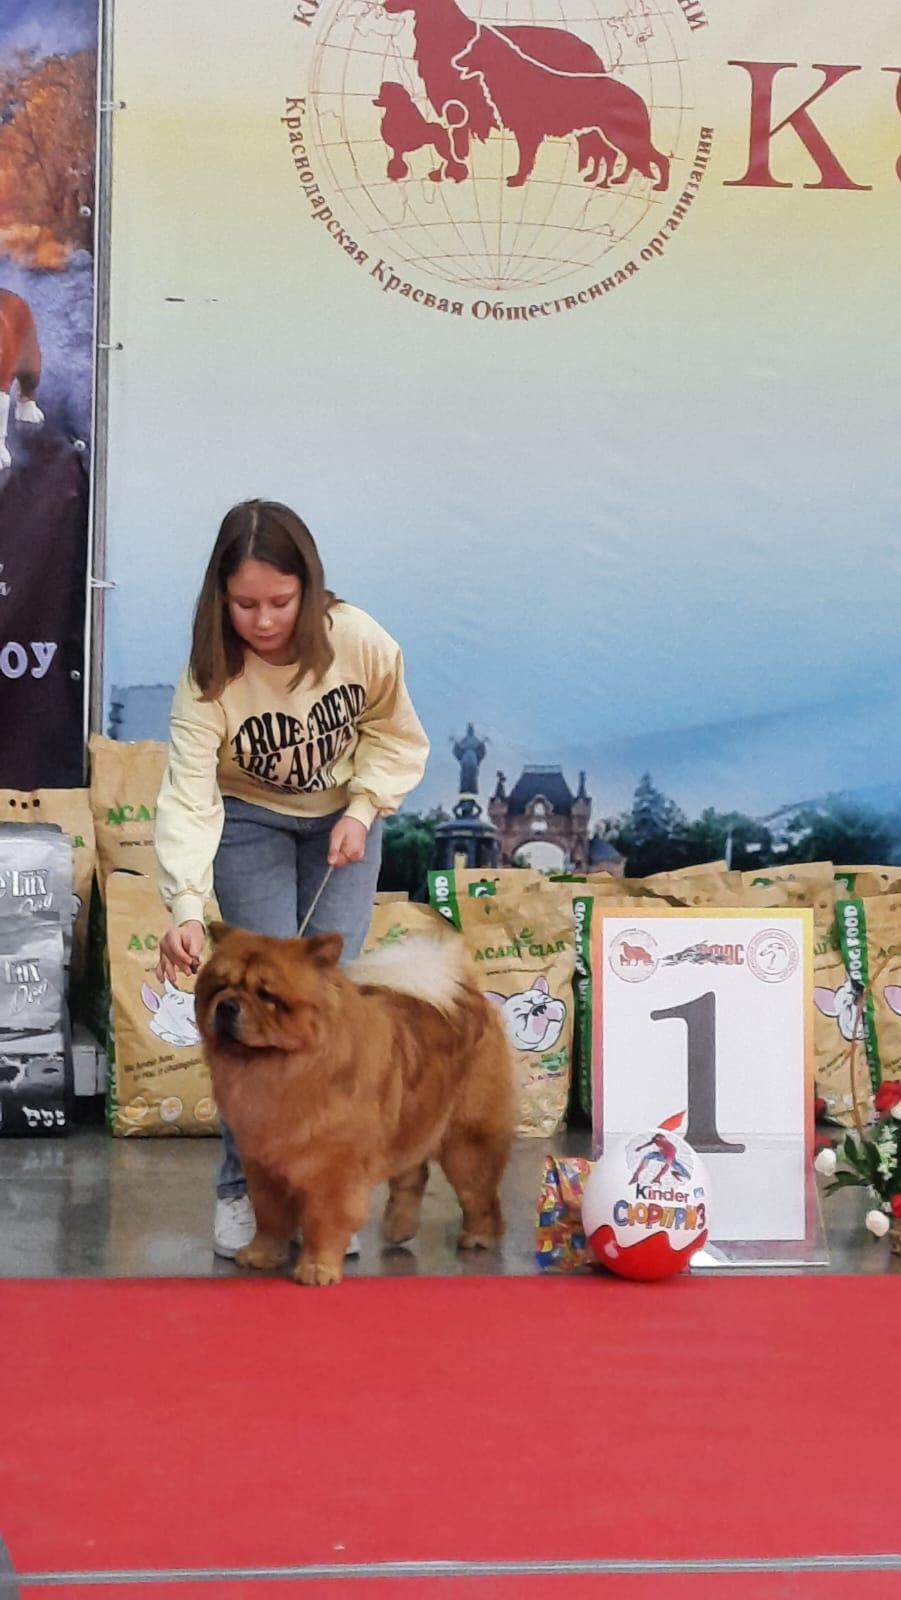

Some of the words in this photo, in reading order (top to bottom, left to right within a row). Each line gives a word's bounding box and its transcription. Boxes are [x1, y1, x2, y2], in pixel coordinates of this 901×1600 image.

[280, 97, 370, 266] Краснодарская
[640, 126, 715, 262] организация
[230, 712, 305, 755] TRUE
[843, 905, 860, 948] FOOD
[649, 990, 747, 1154] 1
[613, 1199, 706, 1230] СЮРПРИЗ
[635, 1183, 691, 1203] Kinder
